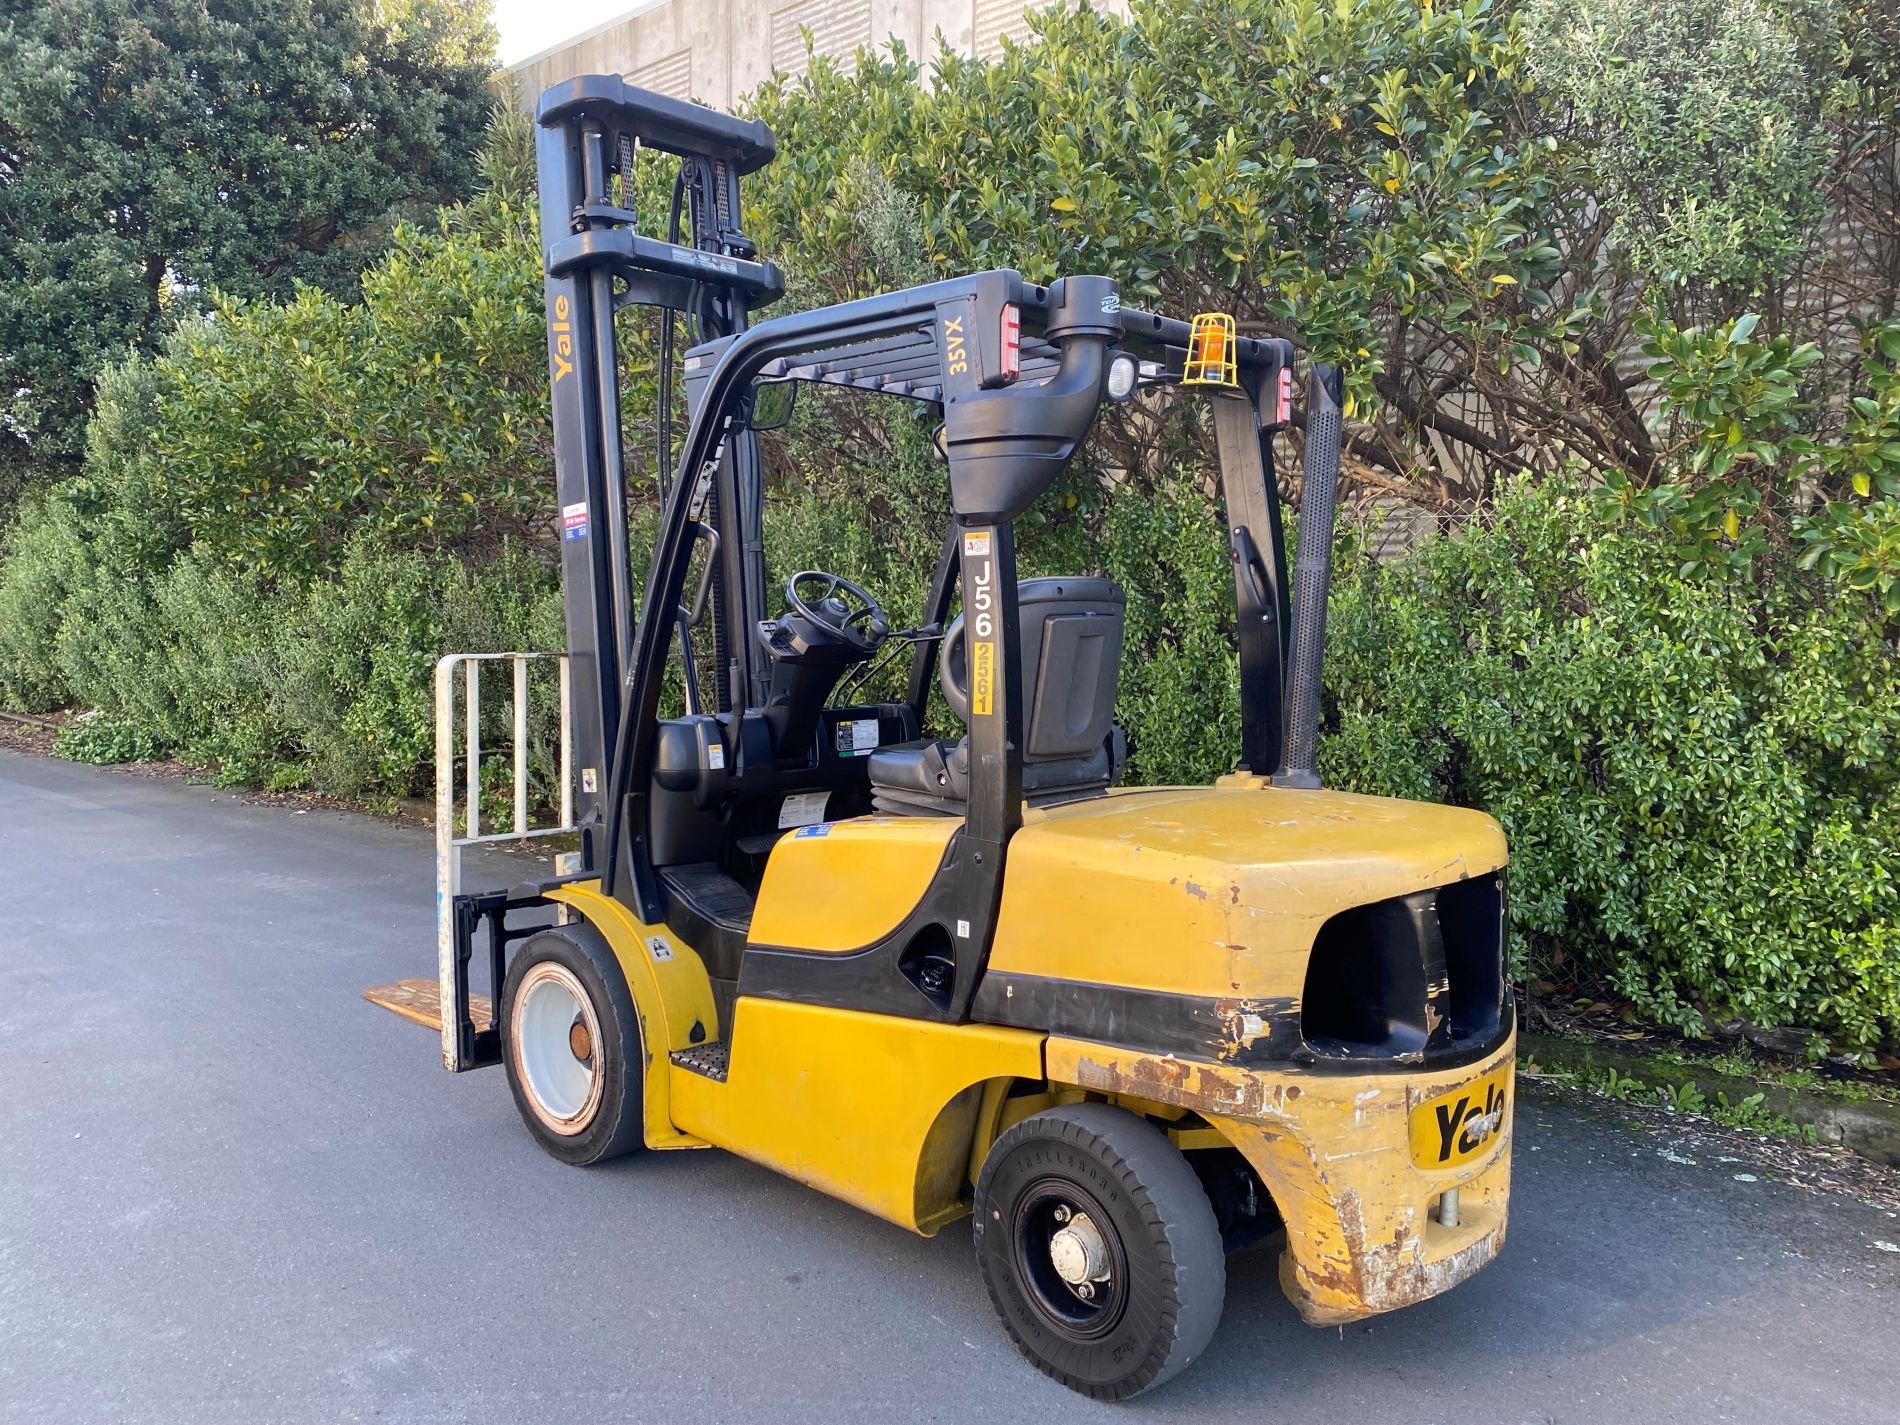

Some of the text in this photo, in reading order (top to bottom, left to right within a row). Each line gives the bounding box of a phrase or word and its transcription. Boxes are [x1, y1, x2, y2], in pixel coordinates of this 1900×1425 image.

[552, 294, 573, 382] Yale
[944, 315, 968, 376] 35VX
[974, 560, 993, 637] J56
[976, 643, 990, 713] 2561
